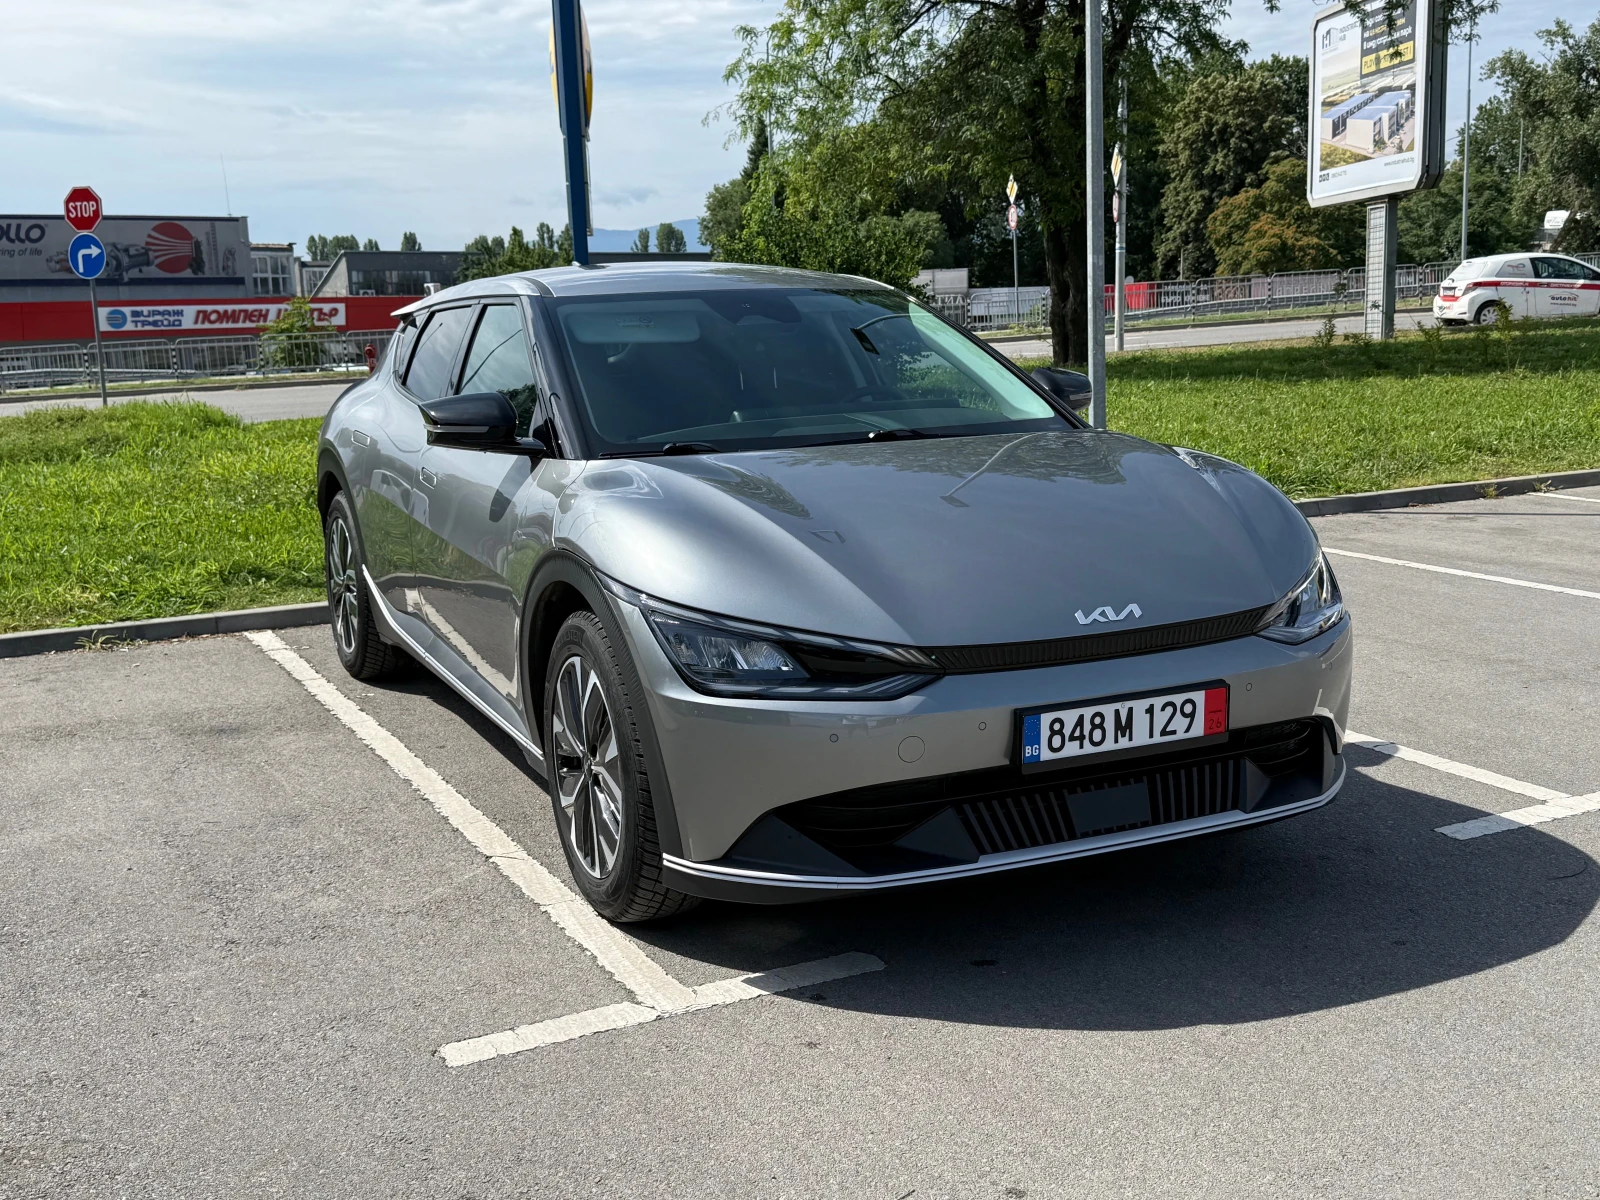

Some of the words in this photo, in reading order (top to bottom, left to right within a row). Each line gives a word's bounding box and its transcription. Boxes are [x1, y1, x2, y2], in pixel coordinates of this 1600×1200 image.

[68, 201, 97, 218] STOP
[193, 308, 270, 325] ПОМПЕН
[1047, 712, 1106, 753] 848
[1113, 707, 1134, 744] M
[1145, 698, 1197, 739] 129
[1208, 717, 1222, 730] 26
[1025, 745, 1039, 757] BG
